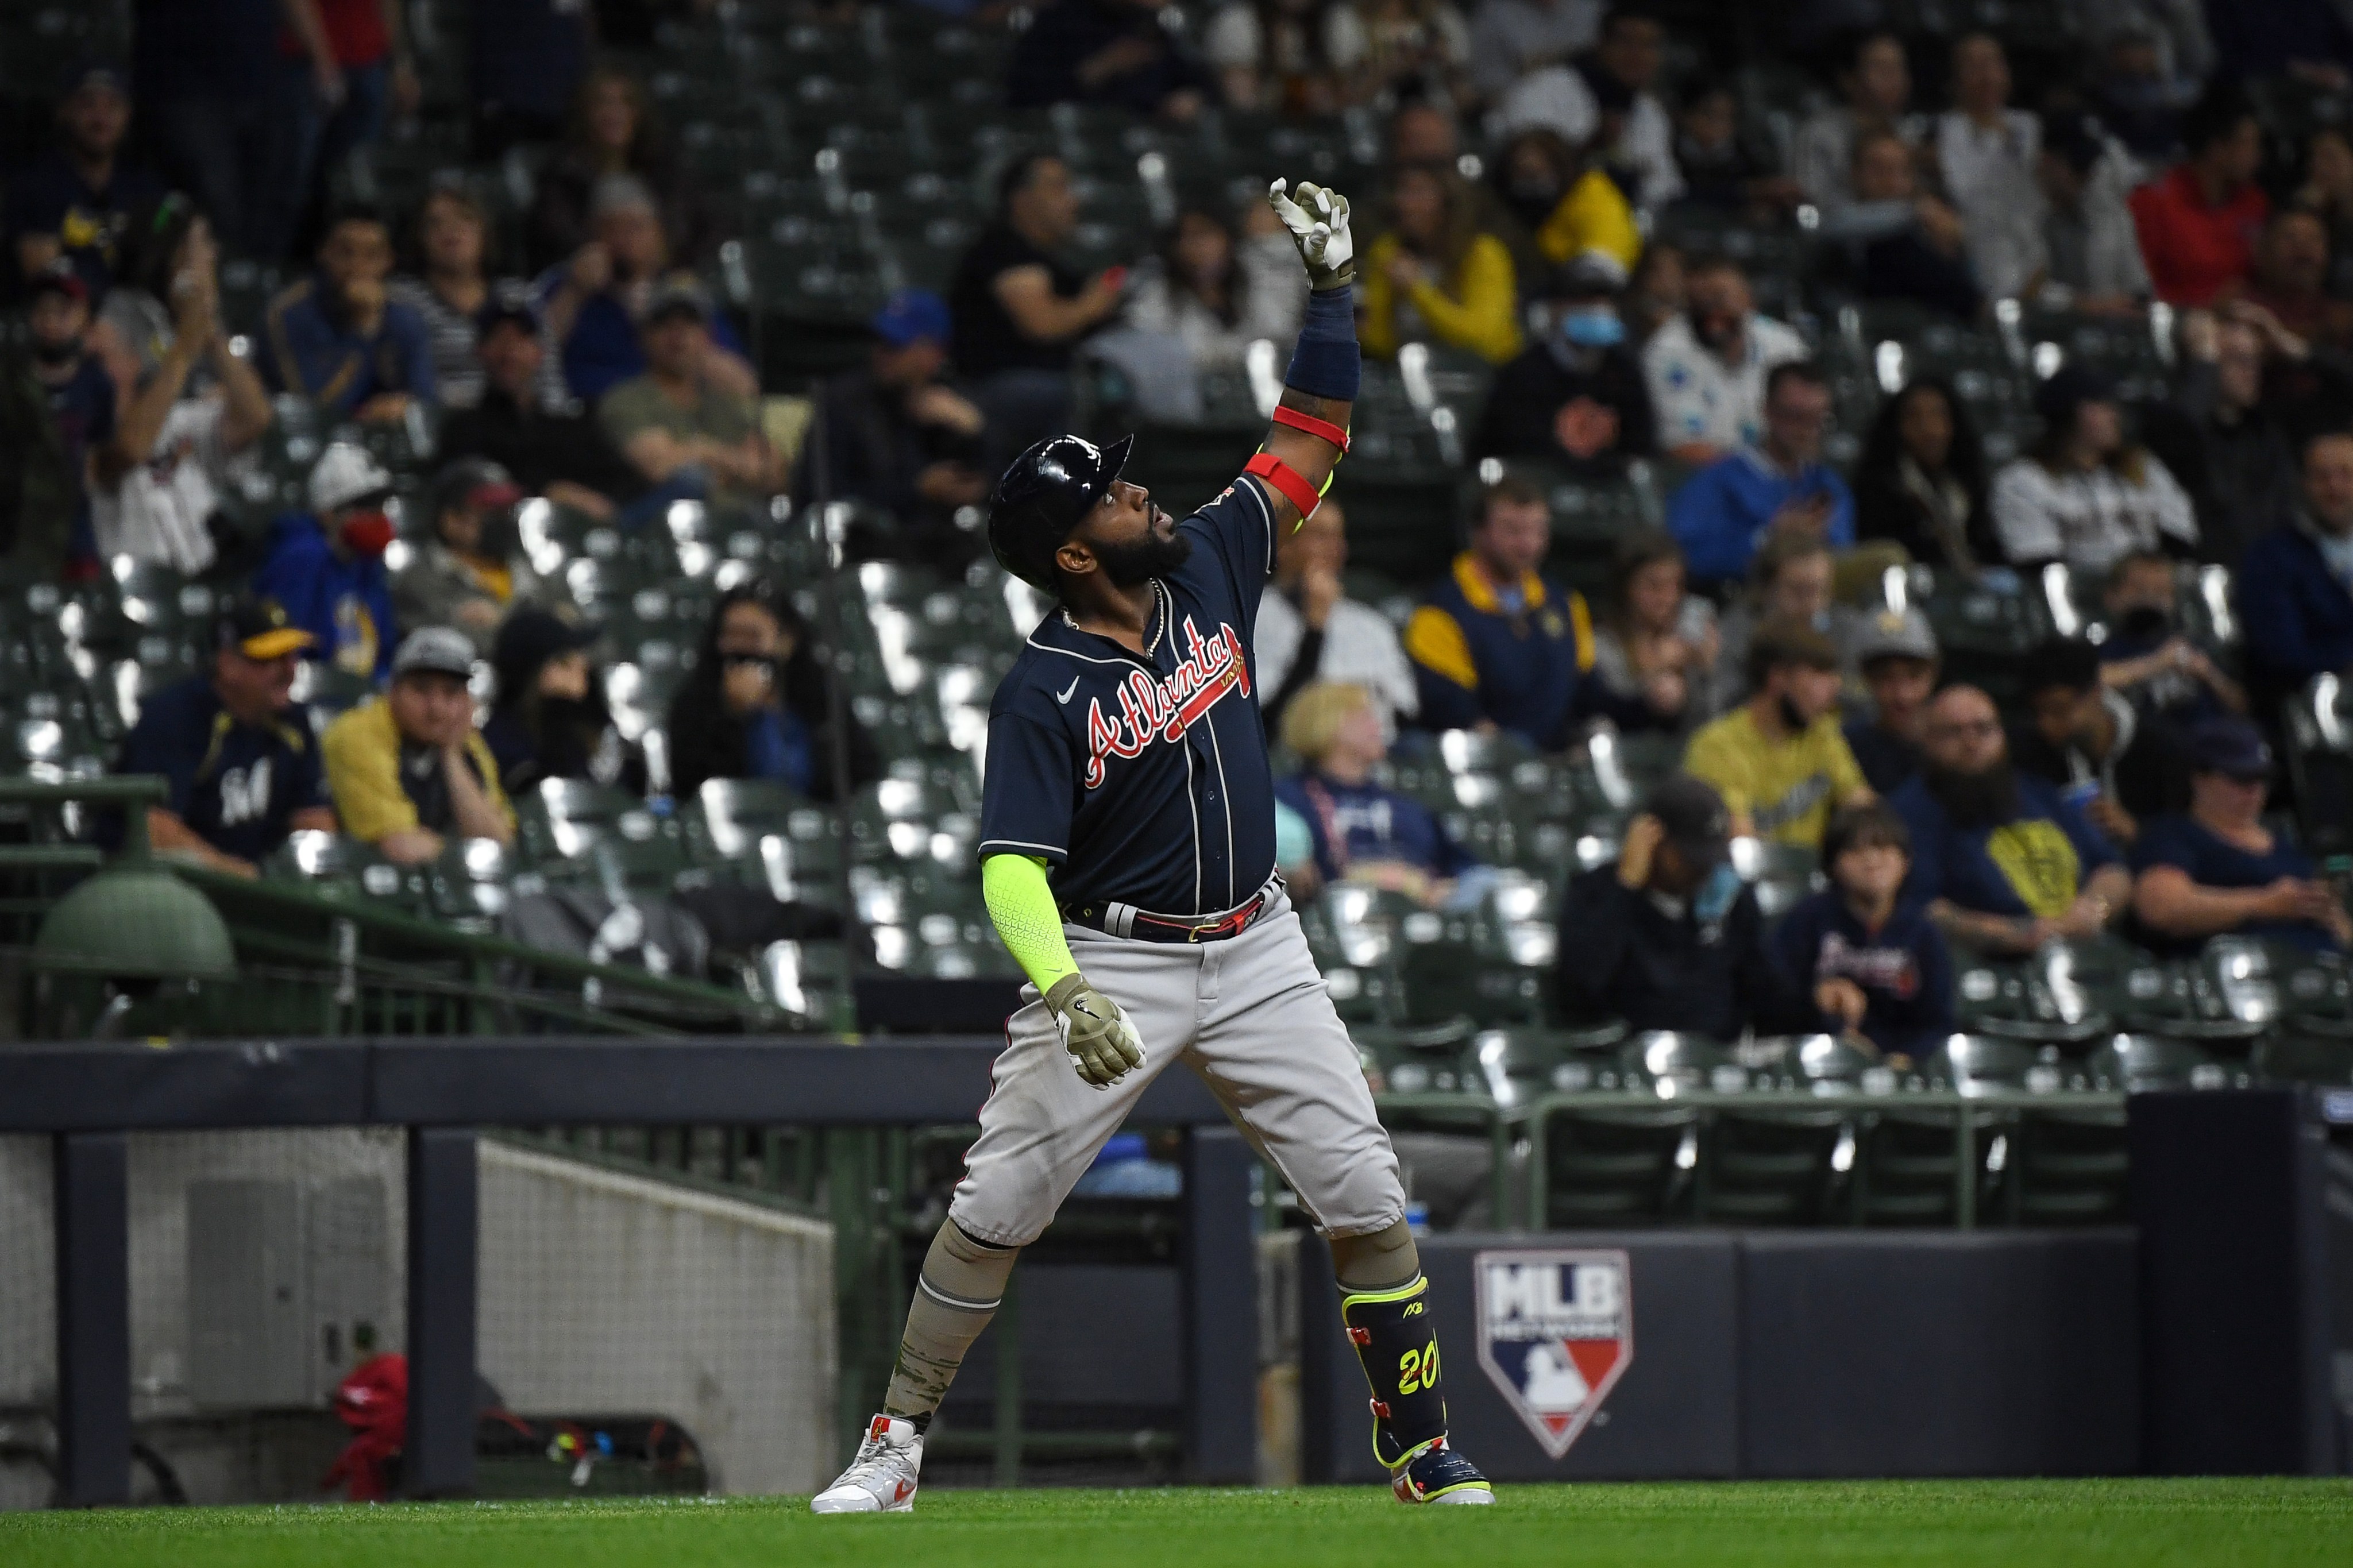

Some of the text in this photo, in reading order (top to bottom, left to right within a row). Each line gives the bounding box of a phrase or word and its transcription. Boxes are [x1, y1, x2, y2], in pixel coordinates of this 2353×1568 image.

[1085, 613, 1228, 789] Atlanta
[1488, 1265, 1618, 1318] MLB
[1399, 1340, 1437, 1395] 20
